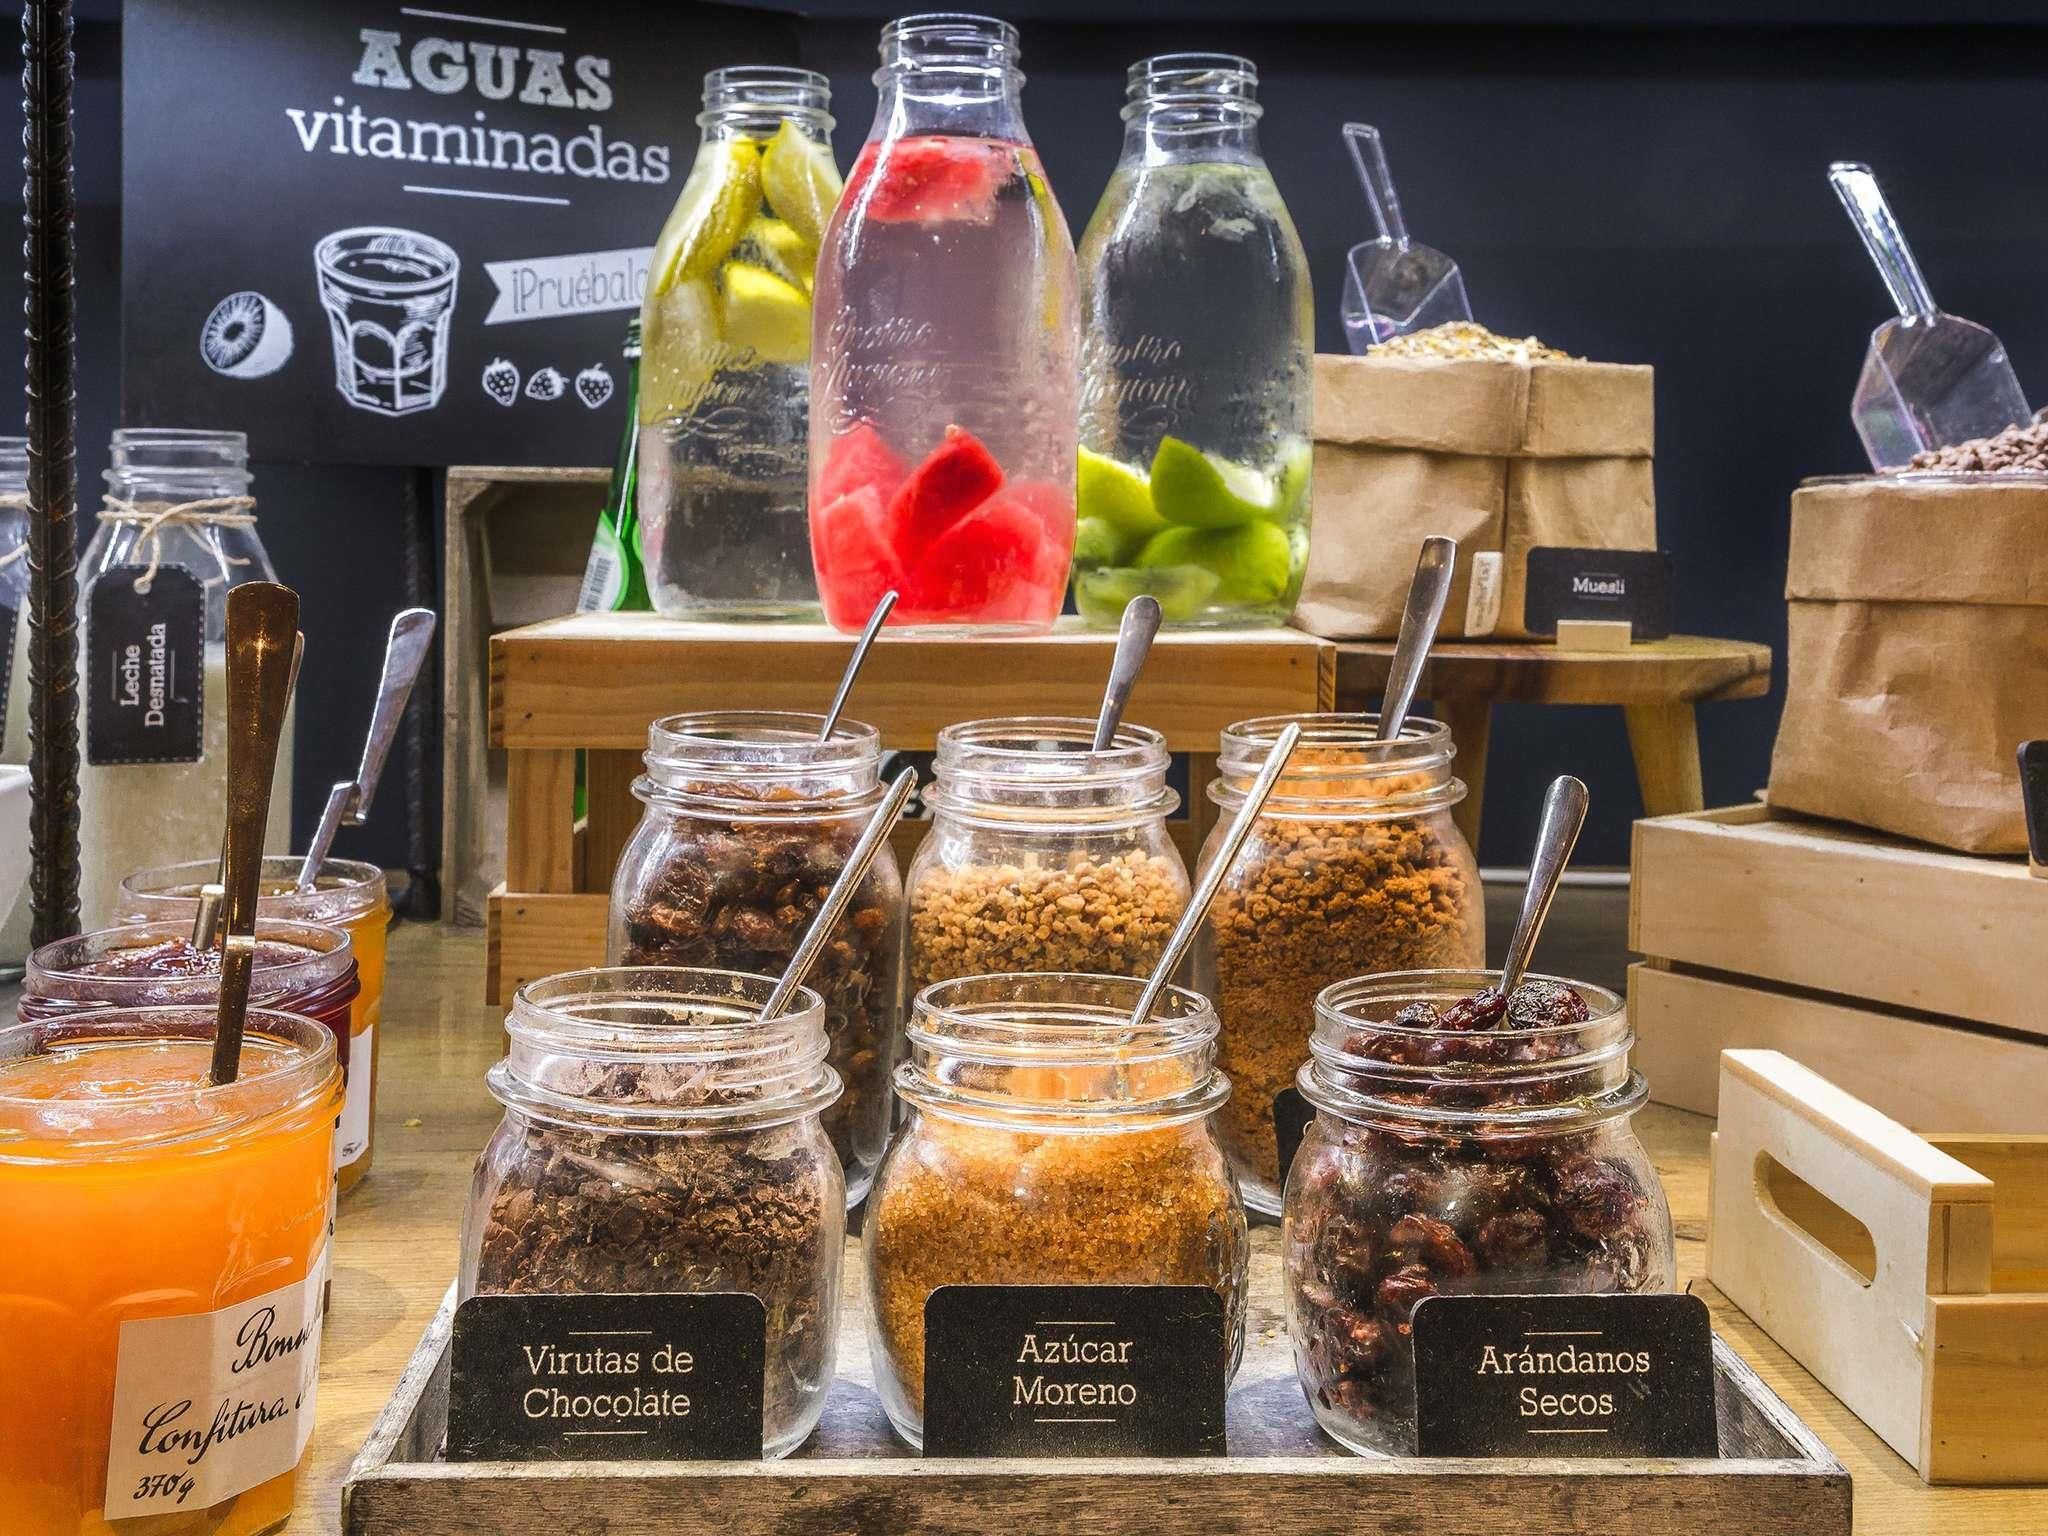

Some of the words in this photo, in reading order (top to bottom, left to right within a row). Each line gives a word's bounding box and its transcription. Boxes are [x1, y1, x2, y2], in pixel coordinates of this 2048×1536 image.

[352, 28, 613, 111] AGUAS
[286, 96, 670, 184] vitaminadas
[1572, 576, 1626, 595] Muesli
[119, 644, 141, 707] Leche
[144, 622, 167, 727] Desnatada
[522, 1345, 640, 1376] Virutas
[651, 1343, 694, 1374] de
[1016, 1332, 1134, 1364] Azúcar
[1477, 1344, 1650, 1375] Arándanos
[523, 1387, 691, 1418] Chocolate
[1012, 1375, 1137, 1406] Moreno
[1519, 1386, 1614, 1417] Secos
[138, 1397, 289, 1466] Confitura
